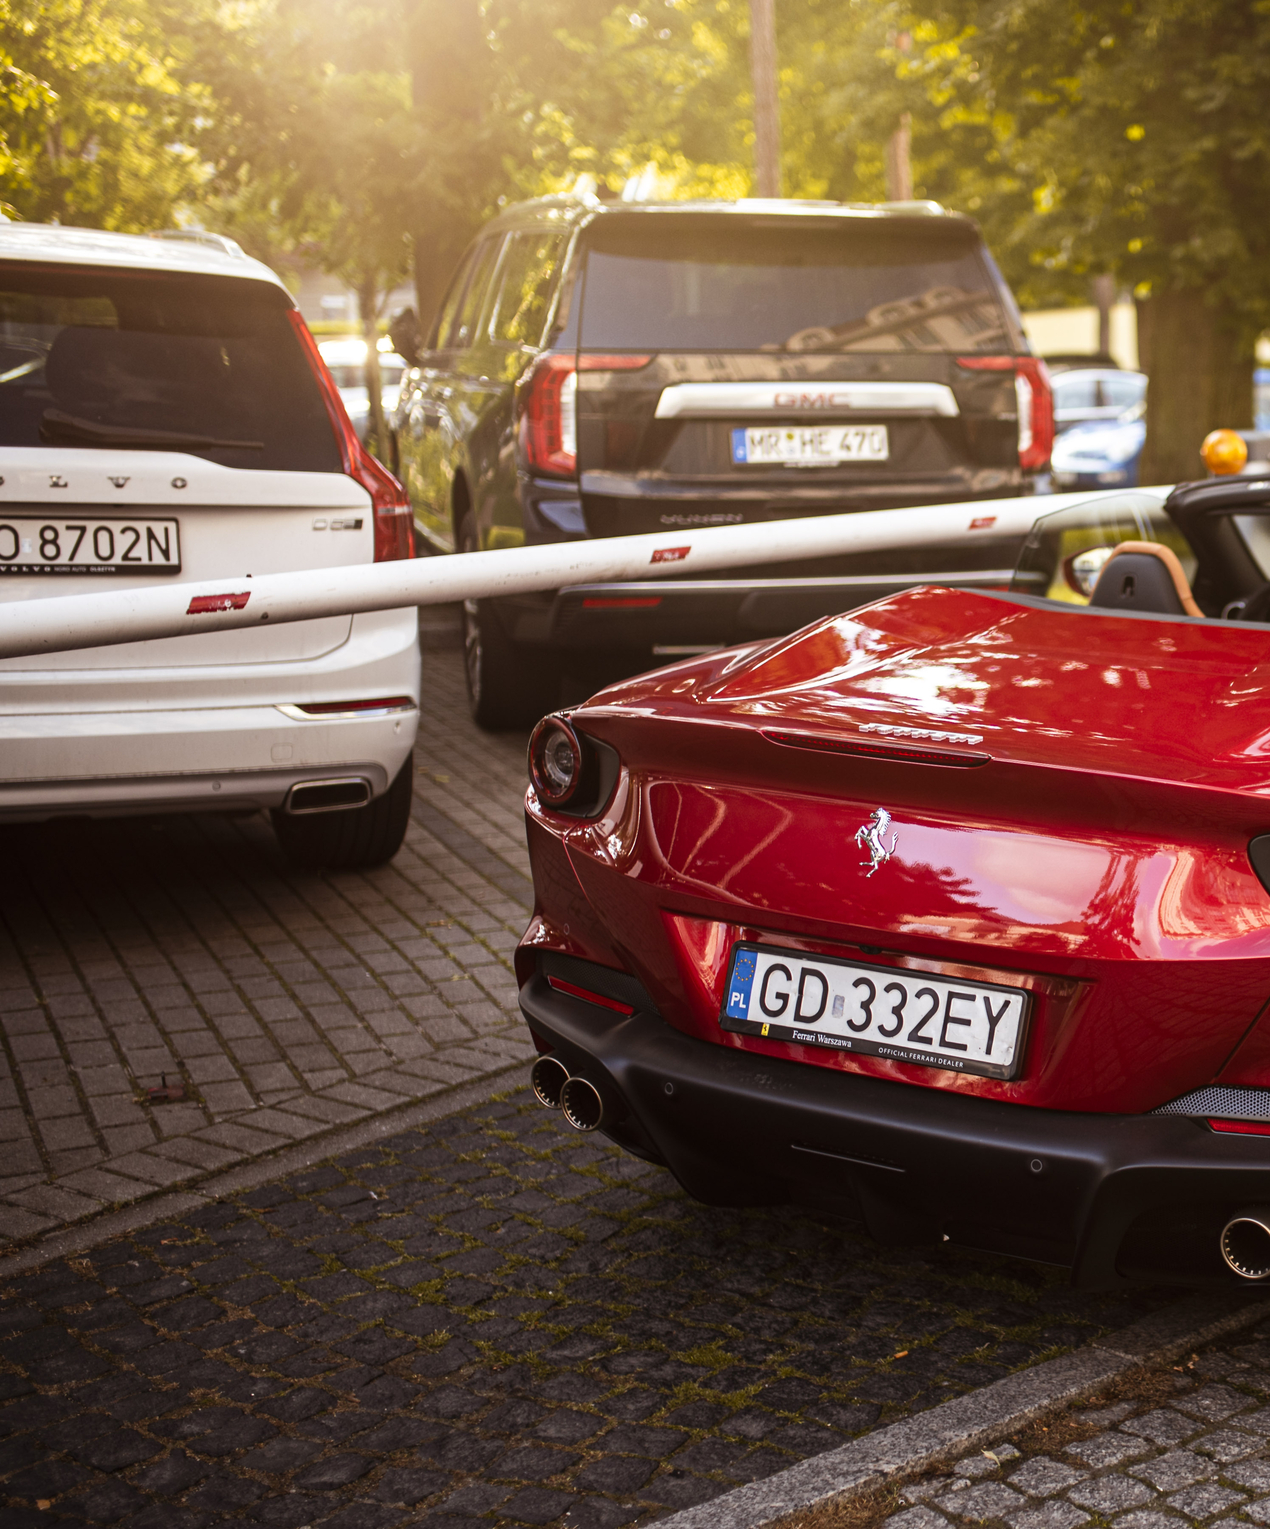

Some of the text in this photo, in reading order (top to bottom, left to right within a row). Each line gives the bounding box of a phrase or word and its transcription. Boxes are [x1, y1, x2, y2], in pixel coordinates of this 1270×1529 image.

[773, 392, 850, 409] GMC
[749, 430, 884, 456] MR HE 470
[39, 524, 171, 562] 8702N
[0, 565, 51, 573] VOLVO
[730, 963, 1012, 1056] PL GD 332EY
[792, 1029, 852, 1049] Ferrari Warszawa
[878, 1047, 964, 1068] OFFICIAL FERRARI DEALER
